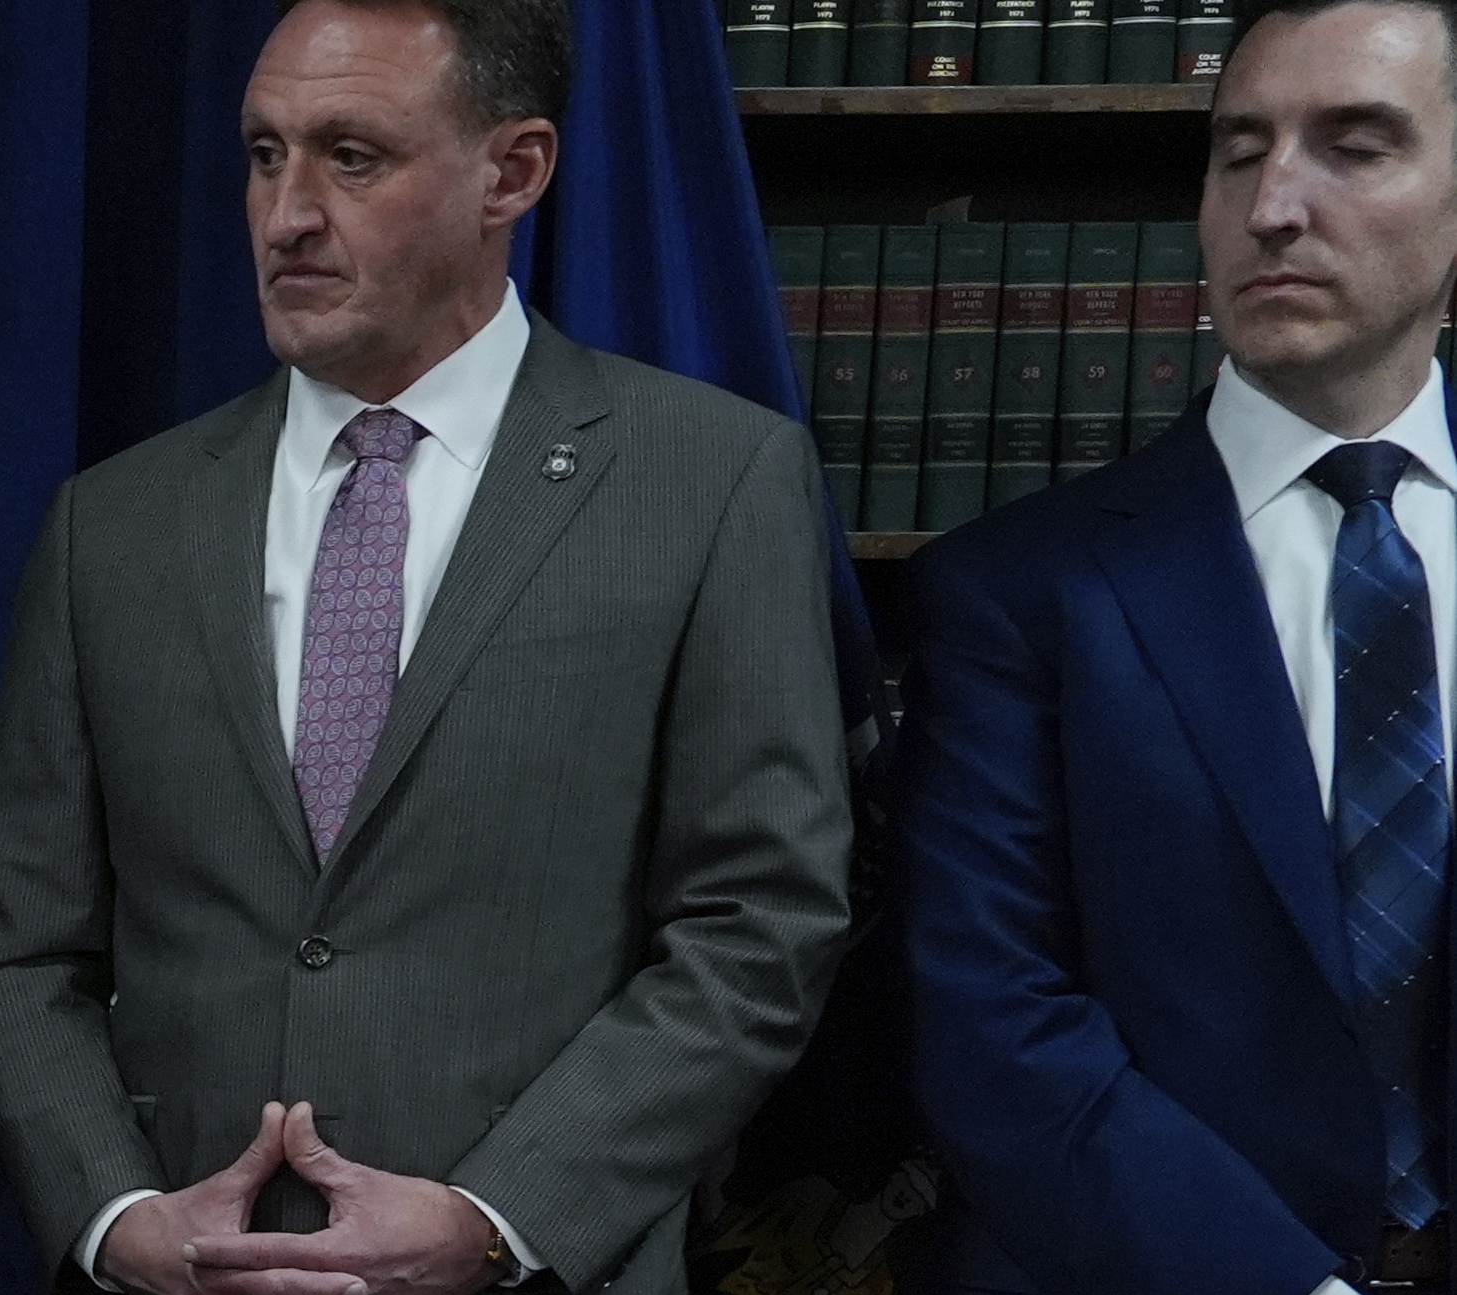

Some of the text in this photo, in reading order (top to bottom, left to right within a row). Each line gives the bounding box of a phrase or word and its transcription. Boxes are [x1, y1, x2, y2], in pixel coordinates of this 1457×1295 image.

[835, 368, 854, 381] 55
[954, 367, 975, 381] 57
[1022, 366, 1040, 379] 58
[1088, 365, 1105, 378] 59
